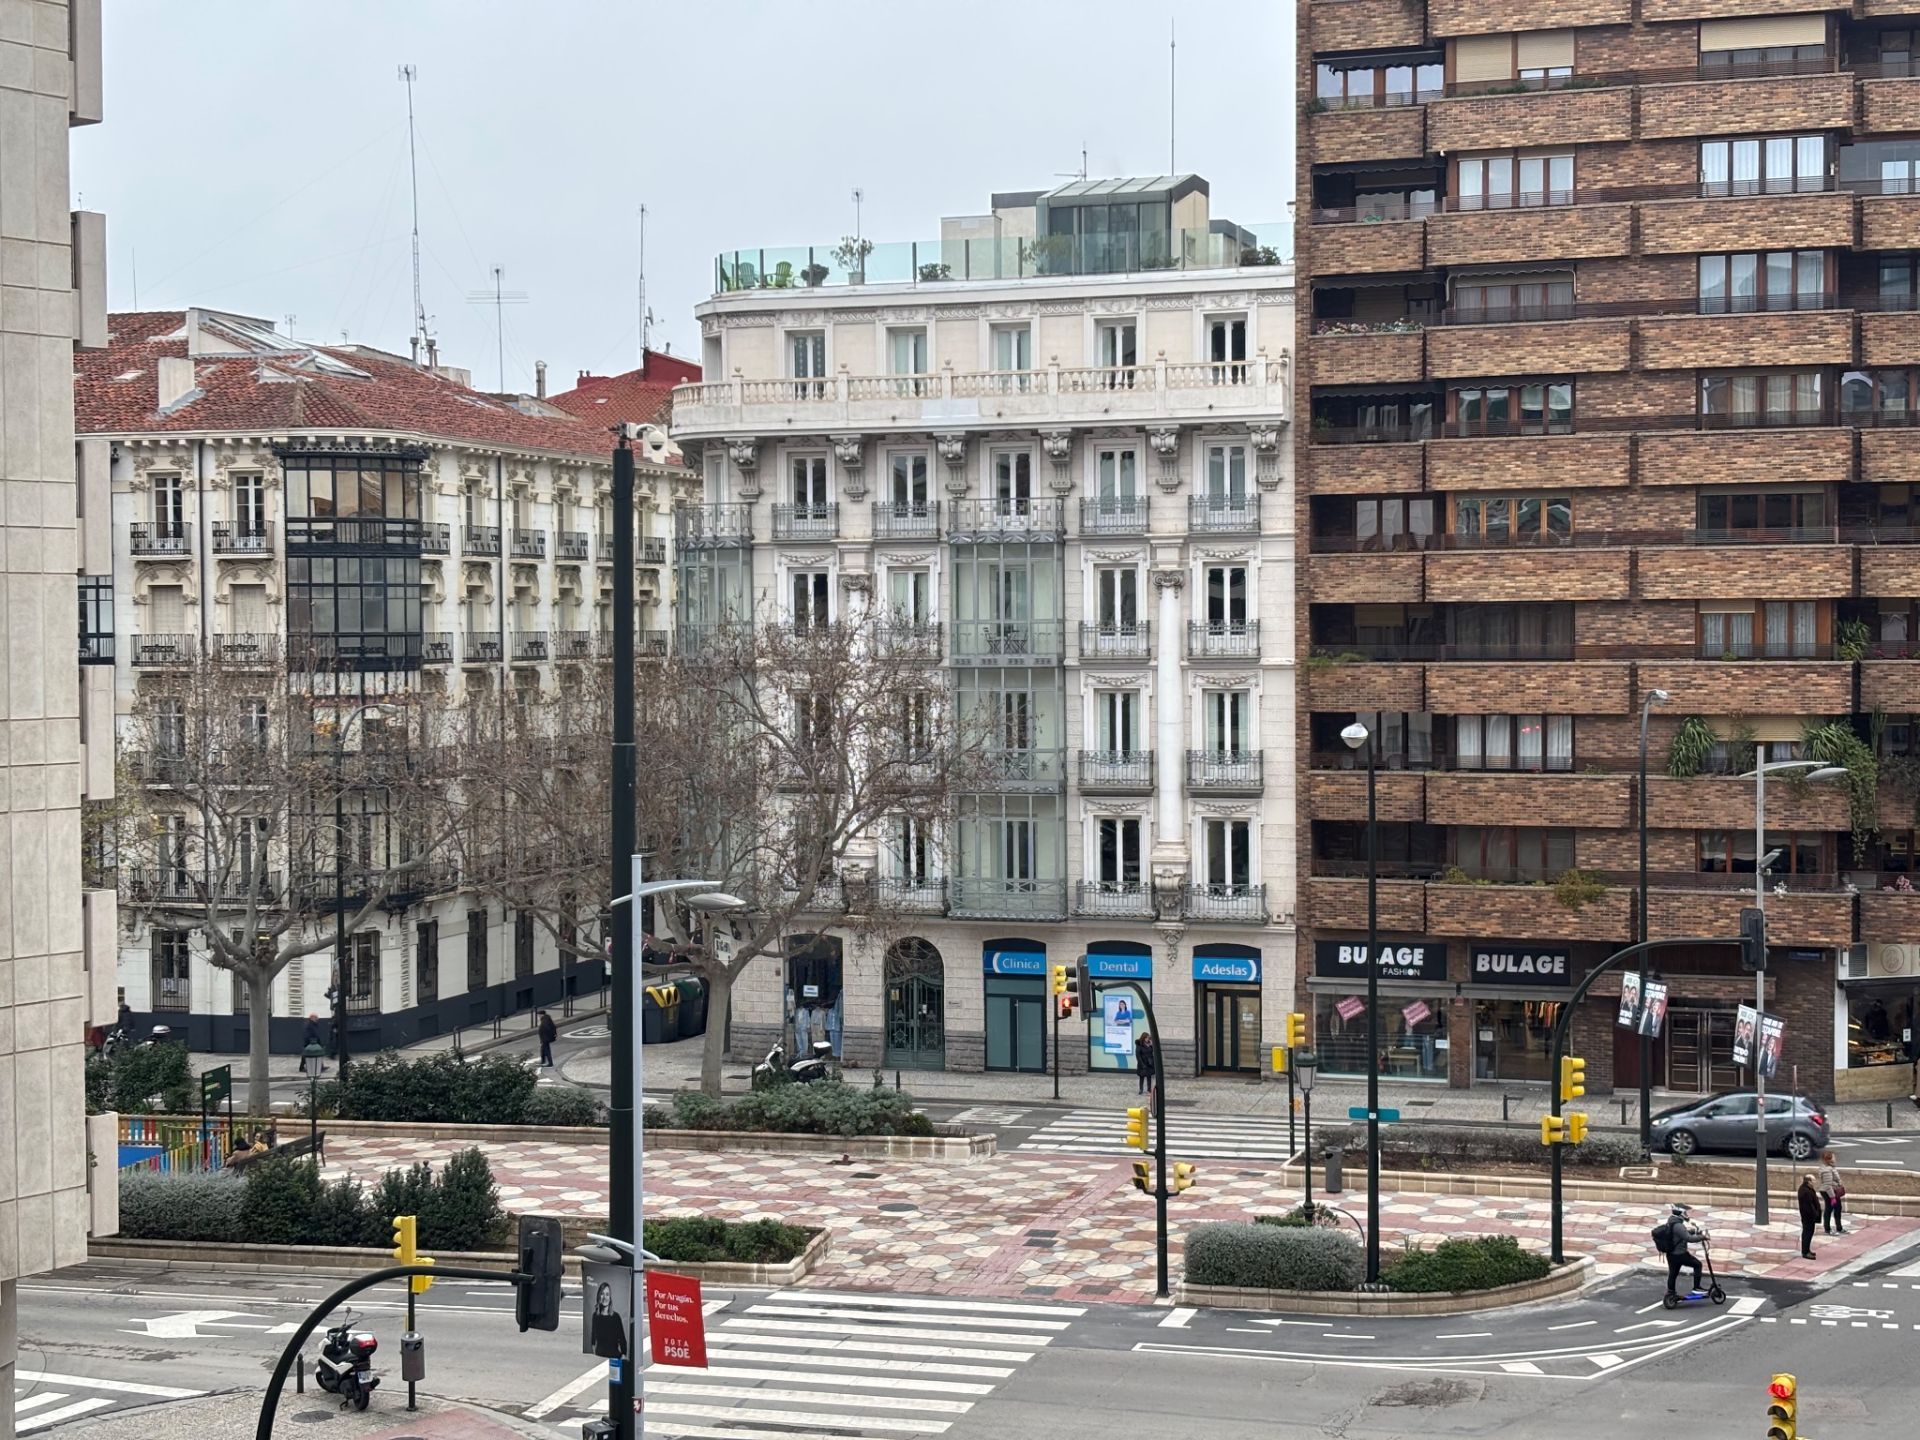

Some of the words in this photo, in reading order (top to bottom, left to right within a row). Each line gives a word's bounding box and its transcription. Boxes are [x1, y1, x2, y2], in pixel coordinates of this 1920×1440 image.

[1338, 945, 1424, 966] BUAGE
[1100, 960, 1138, 972] Dental
[1476, 953, 1565, 974] BULAGE
[1201, 964, 1248, 976] Adeslas
[1382, 967, 1420, 976] FASHION
[654, 1289, 666, 1299] Por
[654, 1300, 666, 1310] Por
[667, 1303, 679, 1311] tus
[654, 1310, 689, 1324] derechos.
[664, 1337, 689, 1347] VOTA
[664, 1345, 691, 1359] PSOE
